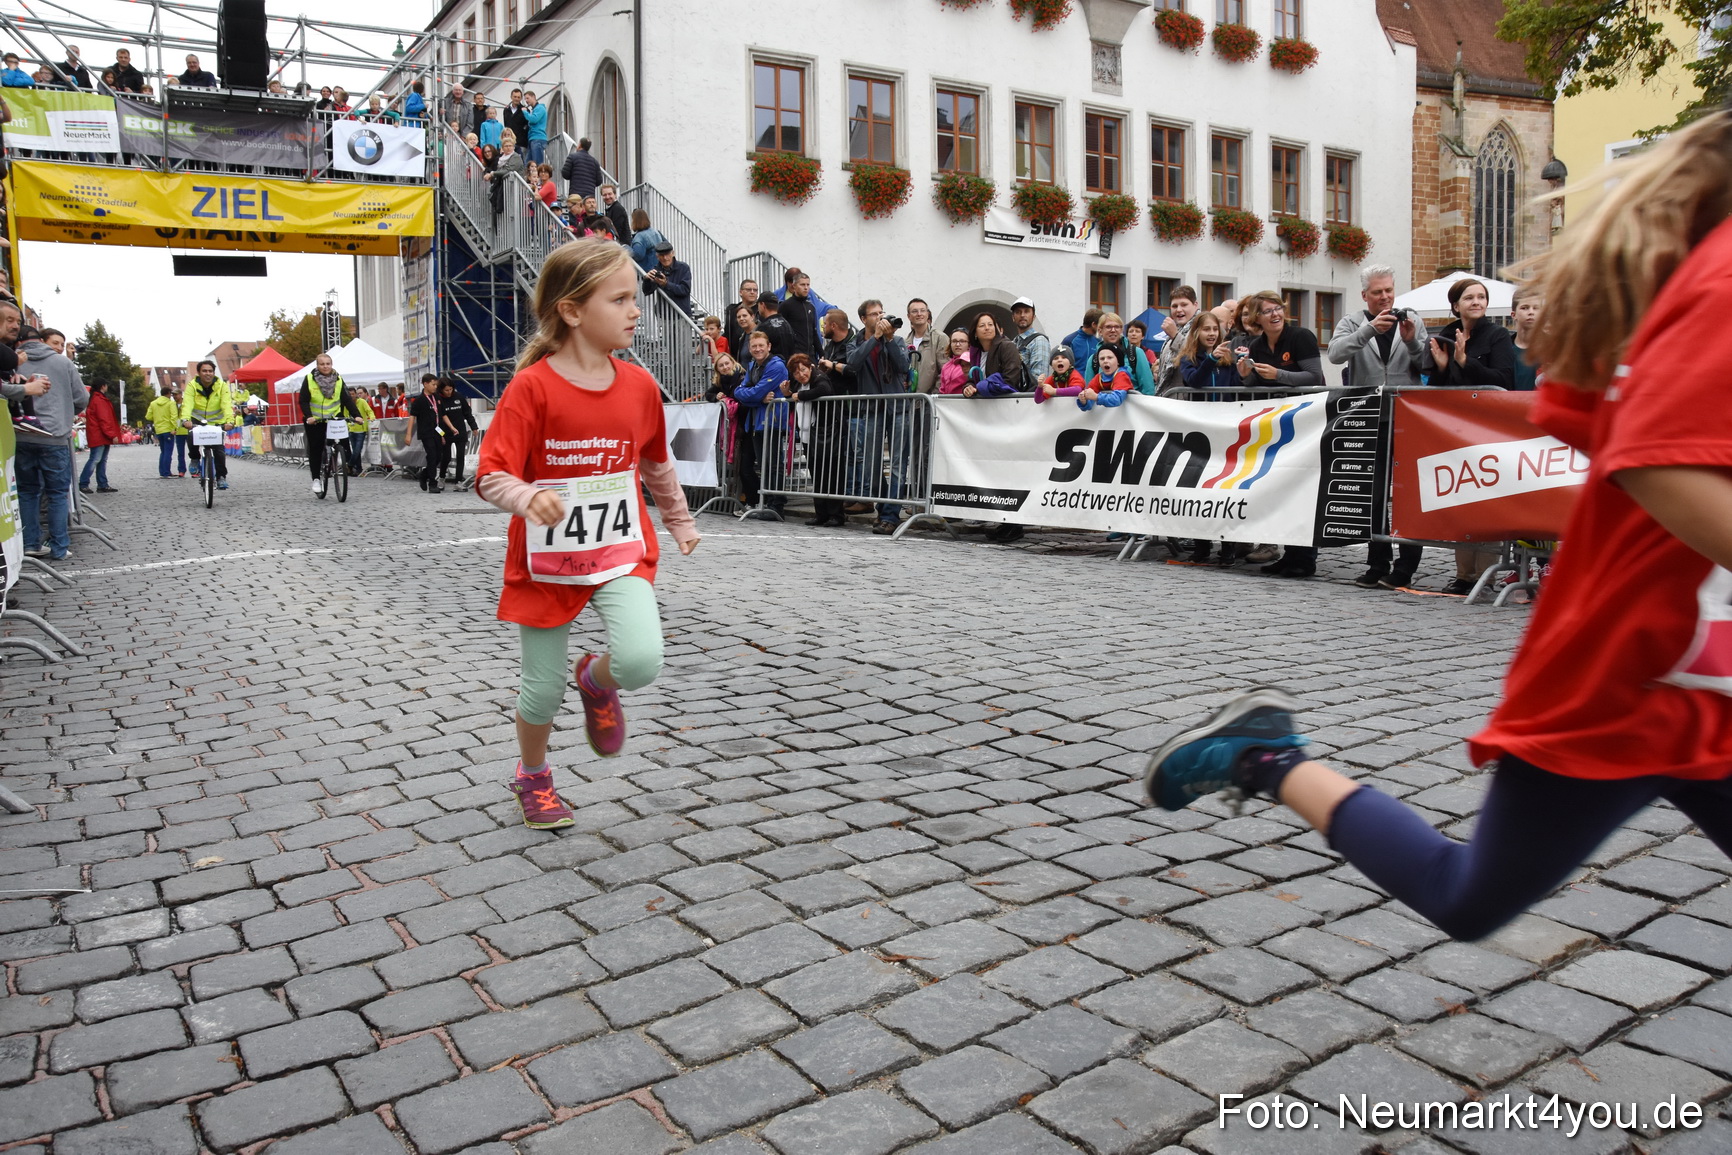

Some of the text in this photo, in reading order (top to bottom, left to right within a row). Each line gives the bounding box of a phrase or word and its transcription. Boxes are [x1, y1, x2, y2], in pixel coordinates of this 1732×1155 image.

[3, 117, 28, 128] nt!
[124, 115, 196, 136] BOCK
[202, 124, 235, 135] OFFICE
[63, 131, 111, 140] NeuerMarkt
[351, 129, 382, 144] BMW
[221, 139, 304, 153] www.bockonline.de
[39, 192, 138, 208] Neumarkter Stadtlauf
[191, 186, 284, 221] ZIEL
[332, 211, 377, 219] Neumarkter
[1030, 219, 1076, 239] swn
[1029, 236, 1087, 248] stadtwerke neumarkt
[545, 437, 620, 450] Neumarkter
[546, 452, 604, 467] Stadtlauf
[1048, 428, 1211, 488] swn
[1434, 454, 1500, 497] DAS
[578, 476, 628, 494] BOCK
[1337, 484, 1360, 492] Freizeit
[933, 490, 1018, 506] Leistungen, die verbinden
[1041, 488, 1248, 520] stadtwerke neumarkt
[1329, 505, 1362, 513] Stadtbusse
[1326, 527, 1362, 536] Parkhäuser
[556, 555, 598, 576] Mirja
